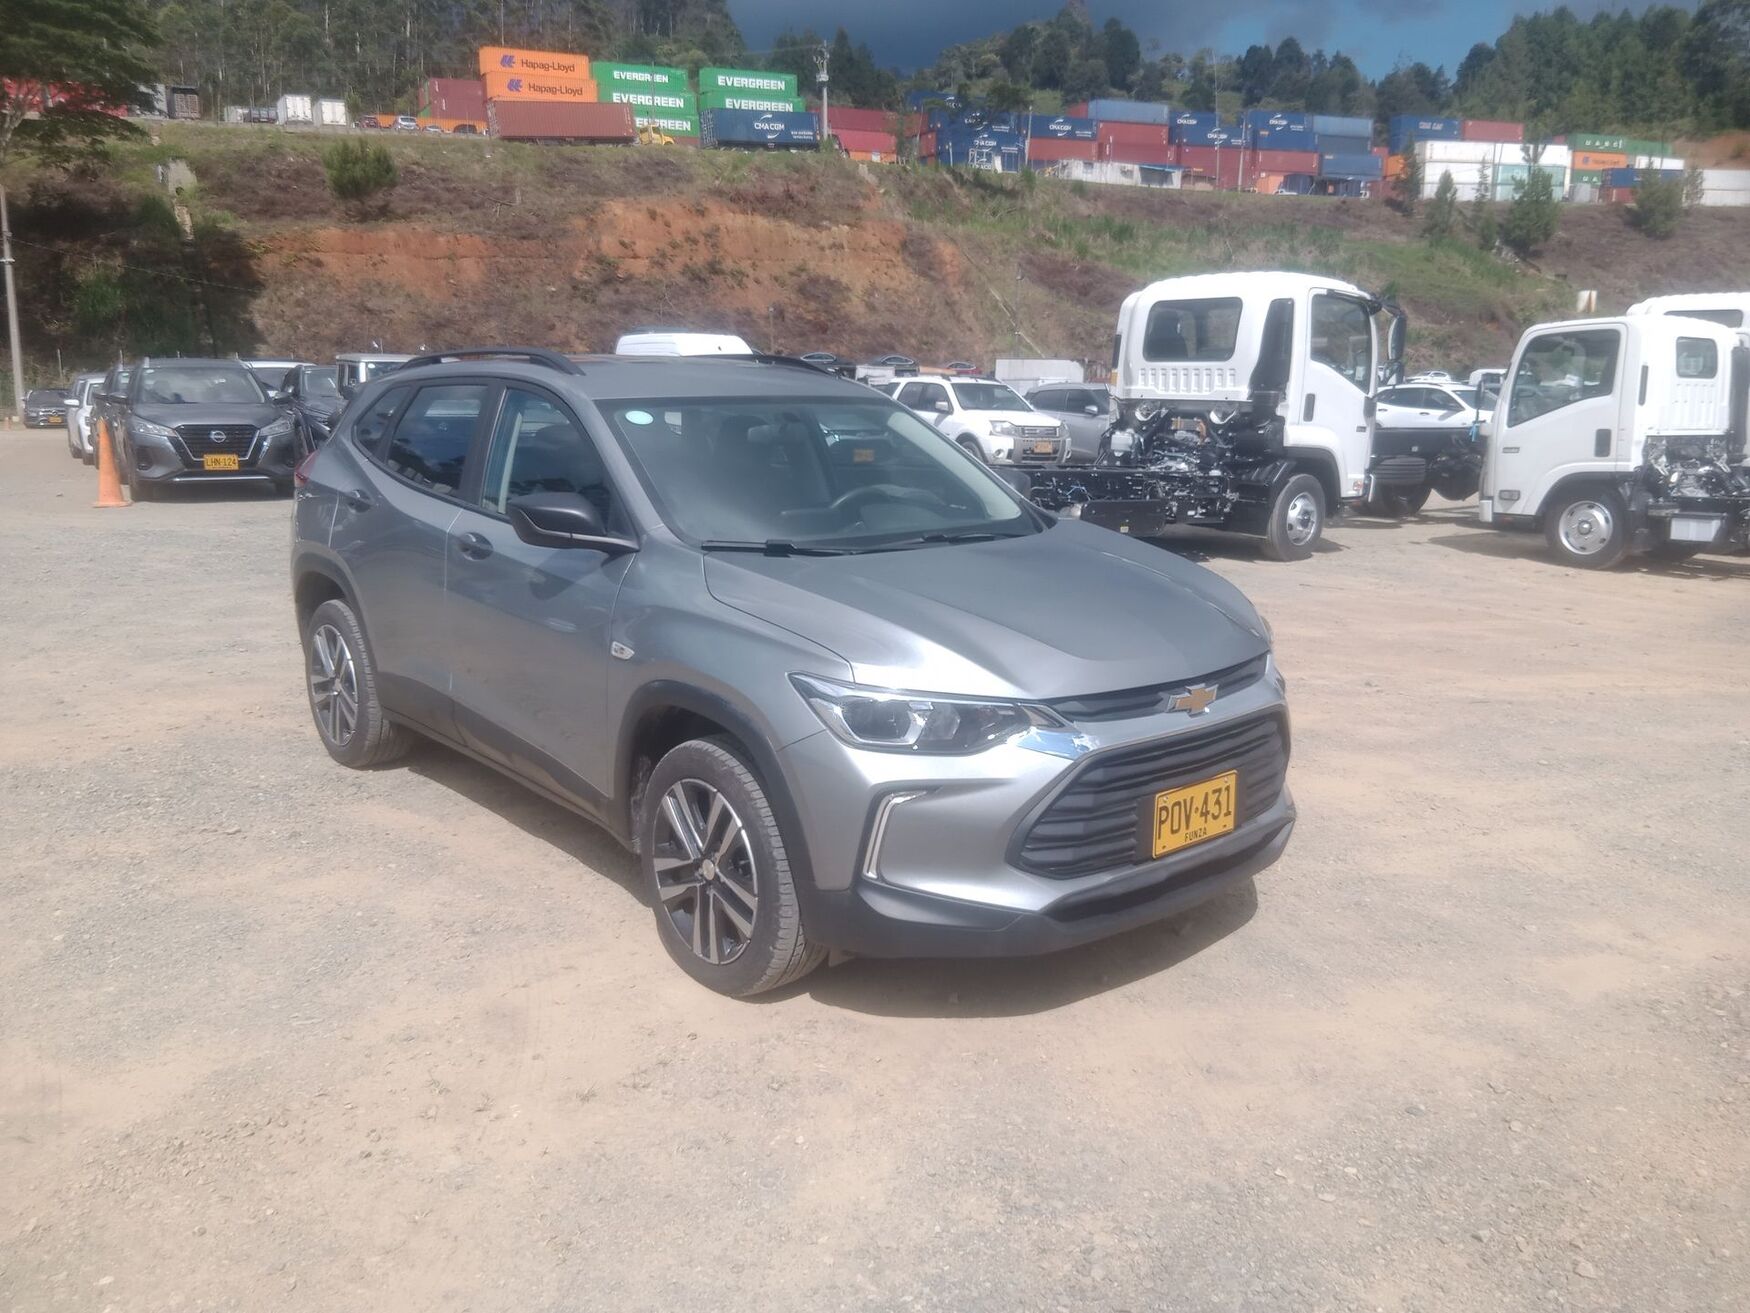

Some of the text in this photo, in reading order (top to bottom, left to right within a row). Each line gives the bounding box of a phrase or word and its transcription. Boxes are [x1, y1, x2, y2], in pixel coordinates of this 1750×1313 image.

[521, 58, 575, 73] Hapag-Lloyd
[528, 82, 583, 97] Hapag-Lloyd
[717, 75, 785, 91] EVERGREEN
[612, 92, 684, 109] EVERGREEN
[725, 98, 793, 112] EVERGREEN
[754, 122, 785, 131] CMA CGM
[1184, 827, 1208, 843] FUNZA
